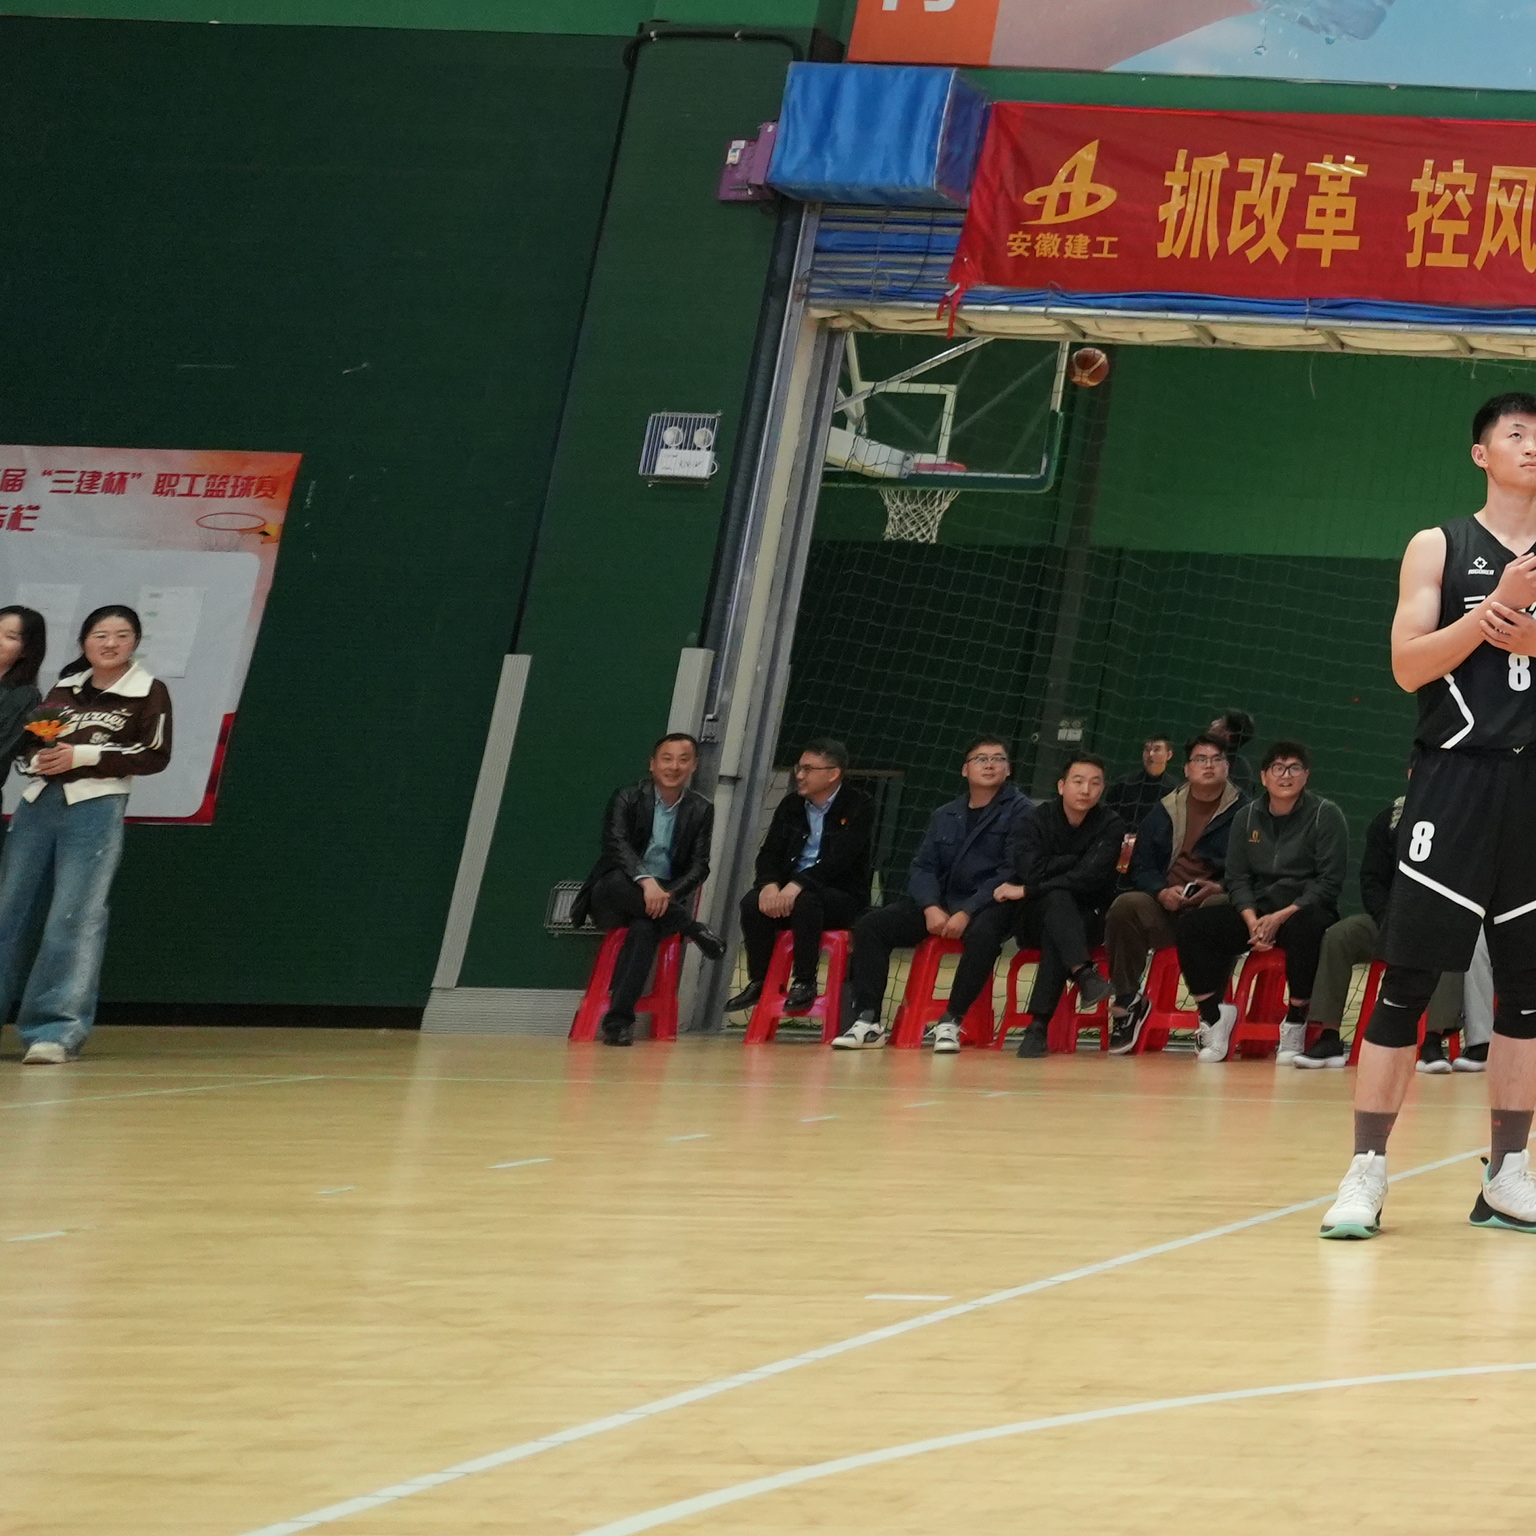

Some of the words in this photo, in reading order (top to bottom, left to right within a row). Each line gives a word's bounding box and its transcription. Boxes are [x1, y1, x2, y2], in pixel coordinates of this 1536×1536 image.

[1157, 147, 1369, 270] 抓改革
[1006, 229, 1119, 261] 安徽建工
[152, 472, 284, 500] 职工篮球赛
[1508, 652, 1532, 692] 8
[1409, 821, 1436, 862] 8
